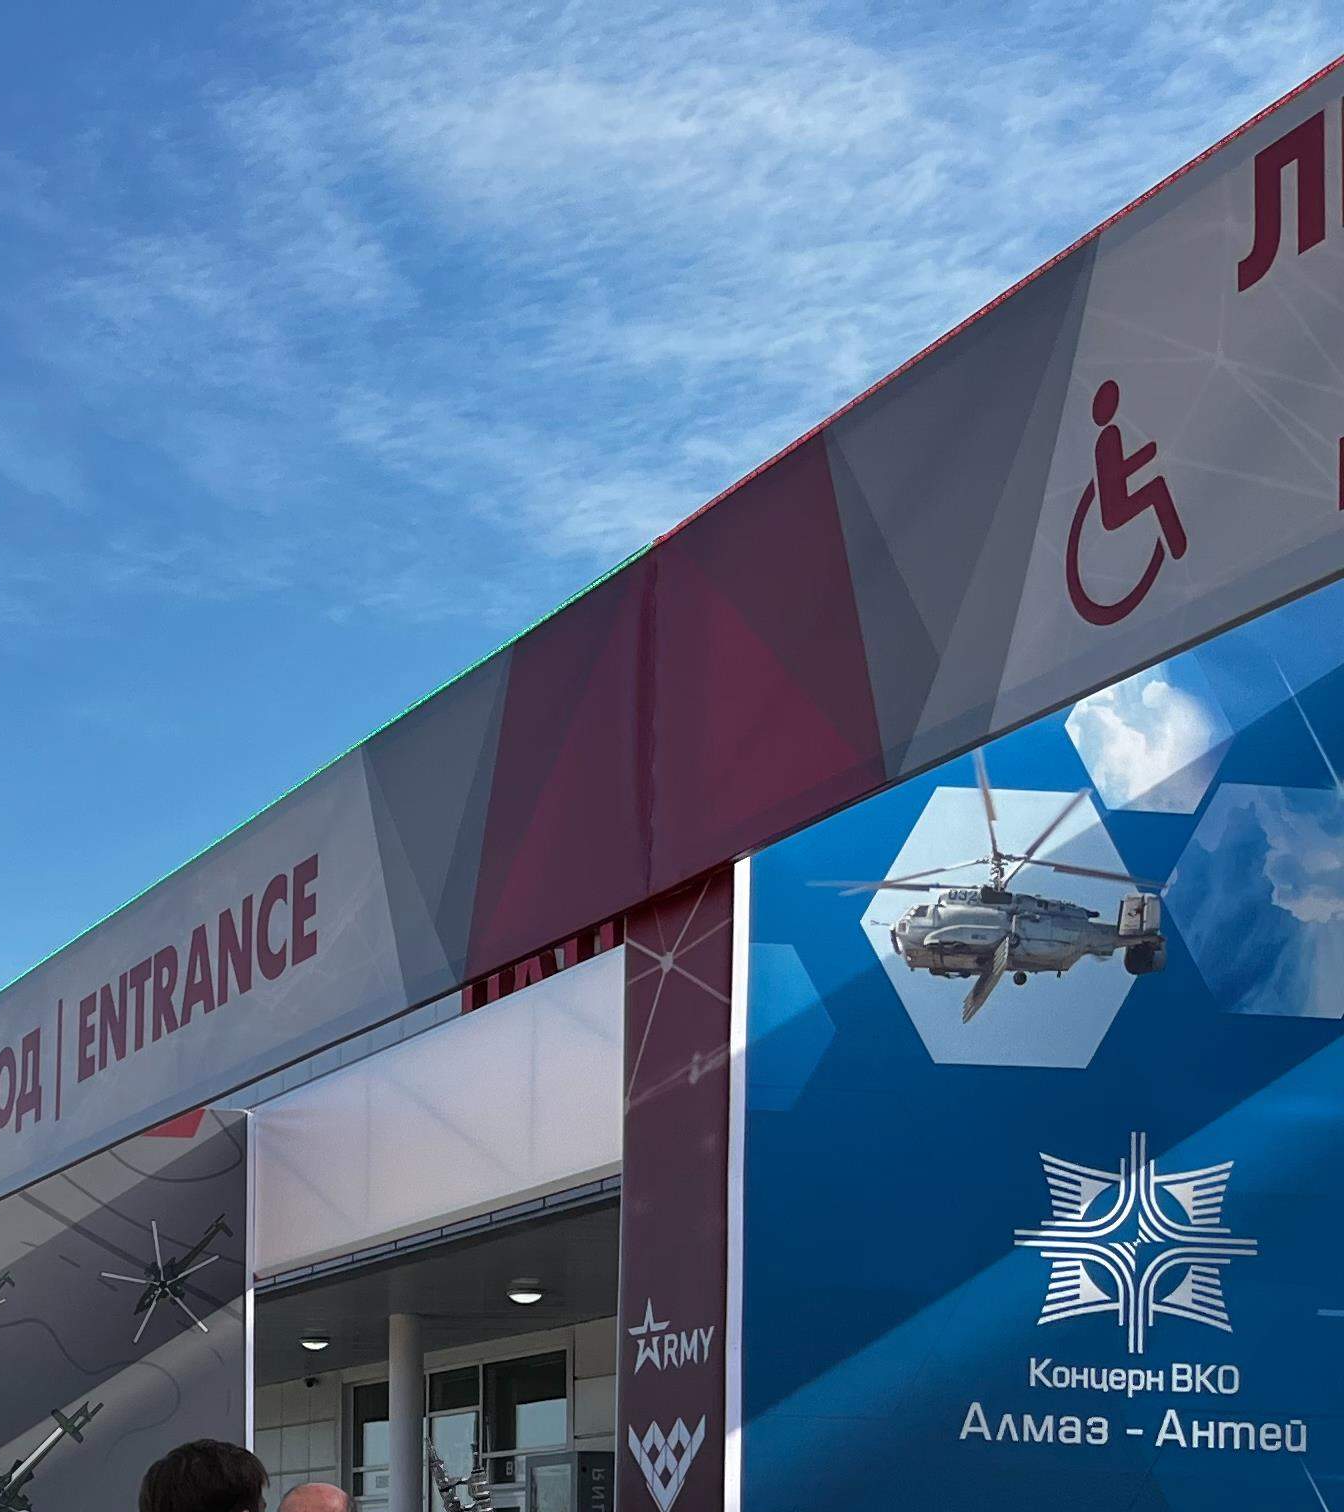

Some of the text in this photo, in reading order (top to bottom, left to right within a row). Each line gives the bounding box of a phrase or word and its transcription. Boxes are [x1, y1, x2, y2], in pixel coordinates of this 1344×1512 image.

[1238, 109, 1344, 292] Л
[77, 853, 319, 1083] ENTRANCE
[628, 1297, 716, 1375] ARMY
[1028, 1357, 1241, 1398] Концерн ВКО
[959, 1401, 1109, 1446] Алмаз
[1155, 1409, 1308, 1453] Антей
